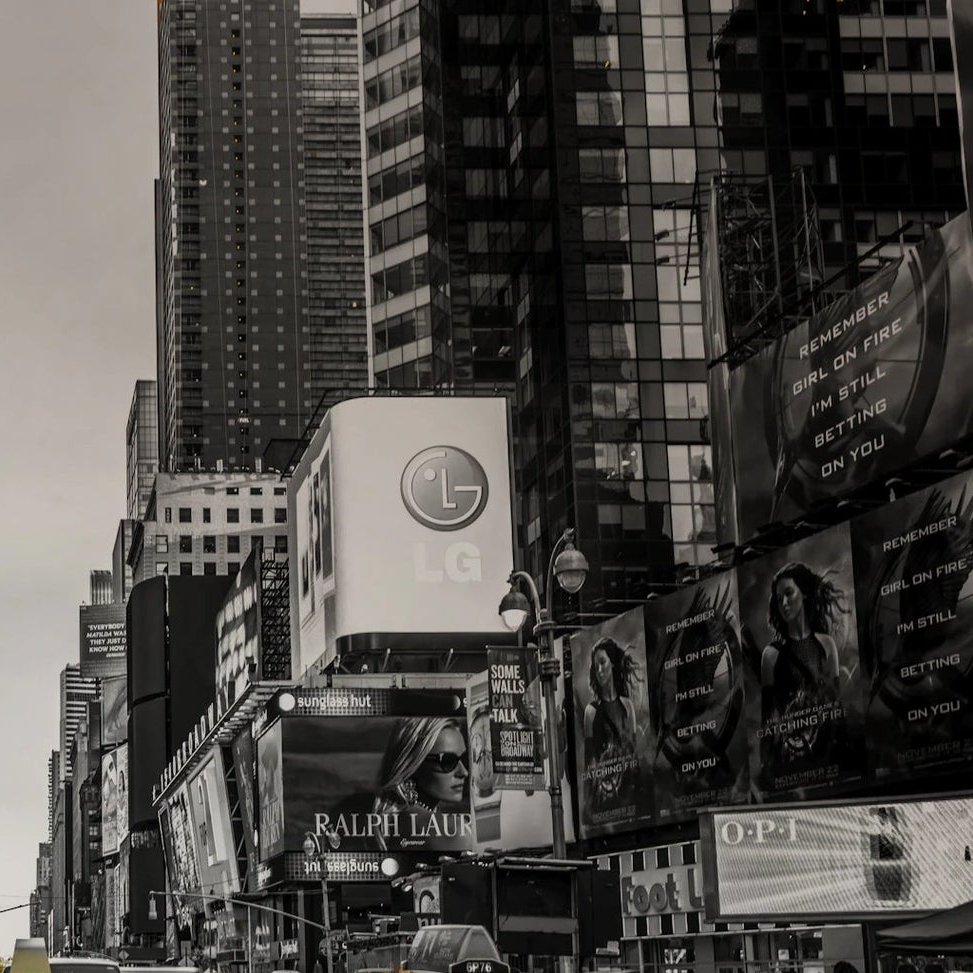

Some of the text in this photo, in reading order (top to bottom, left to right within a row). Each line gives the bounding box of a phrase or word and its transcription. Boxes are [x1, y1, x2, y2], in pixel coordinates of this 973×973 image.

[799, 291, 890, 361] REMEMBER
[792, 318, 903, 396] GIRL ON FIRE
[811, 366, 887, 418] I'M STILL
[814, 398, 888, 449] BETTING
[821, 434, 886, 478] ON YOU
[882, 514, 958, 553] REMEMBER
[415, 542, 482, 583] LG
[880, 557, 968, 597] GIRL ON FIRE
[665, 607, 715, 634] REMEMBER
[896, 608, 958, 635] I'M STILL
[664, 642, 721, 671] GIRL ON FIRE
[900, 652, 962, 680] BETTING
[490, 664, 521, 679] SOME
[491, 679, 526, 694] WALLS
[675, 683, 715, 703] I'M STILL
[297, 693, 372, 710] sunglass hut
[492, 694, 513, 708] CAN
[907, 698, 961, 722] ON YOU
[492, 708, 518, 723] TALK
[756, 714, 818, 739] CATCHING
[499, 730, 534, 745] SPOTLIGHT
[677, 719, 717, 738] BETTING
[501, 745, 534, 757] BROADWAY
[681, 757, 716, 774] ON YOU
[314, 812, 401, 837] RALPH
[410, 812, 472, 837] LAUR
[327, 858, 380, 874] sunglass
[621, 872, 682, 916] foot
[466, 961, 492, 973] 6P76
